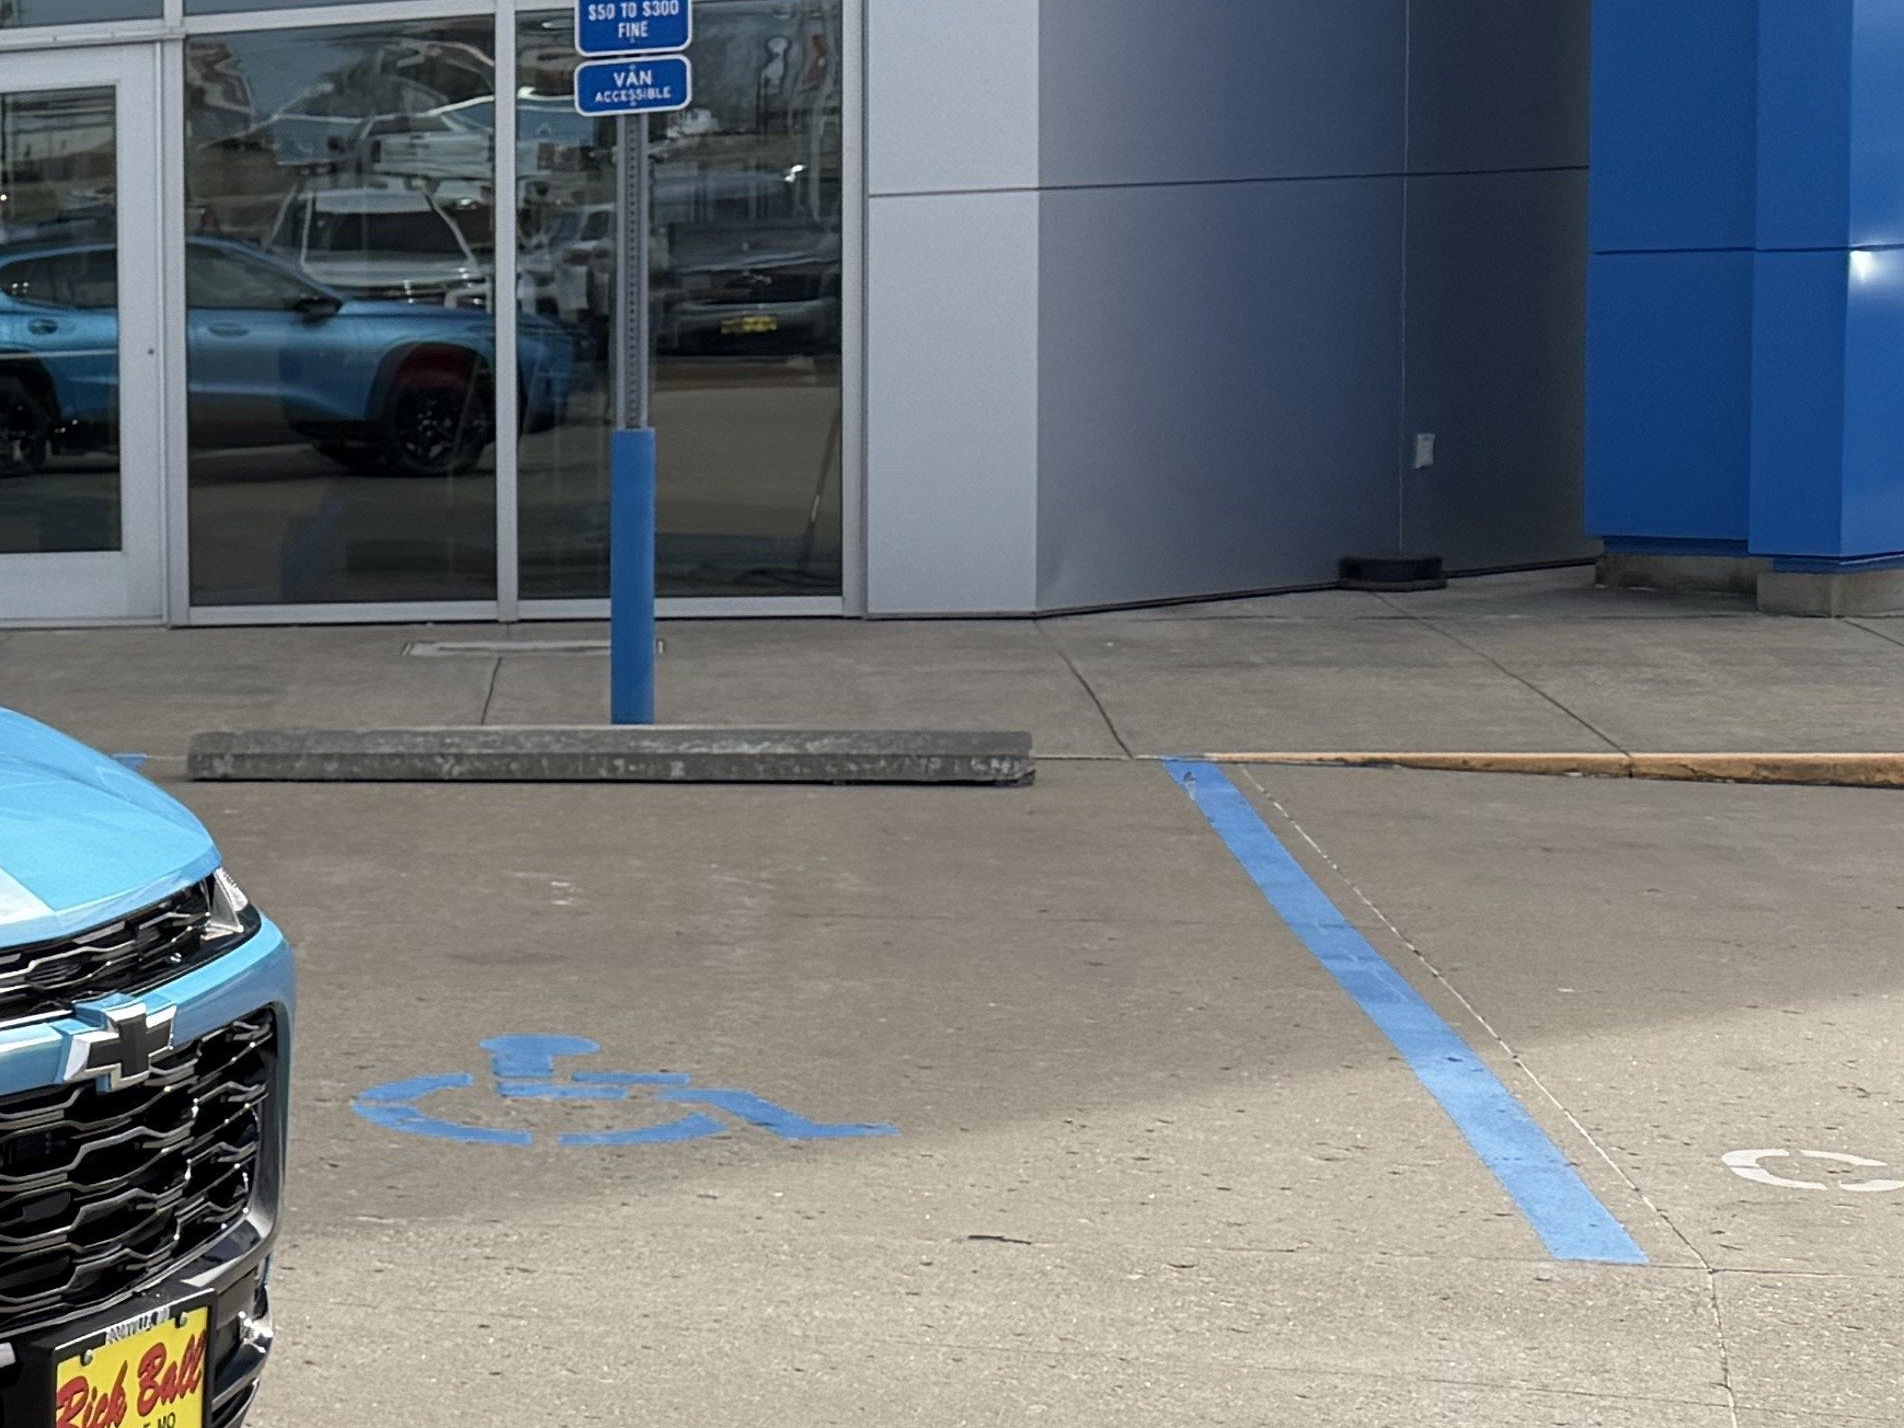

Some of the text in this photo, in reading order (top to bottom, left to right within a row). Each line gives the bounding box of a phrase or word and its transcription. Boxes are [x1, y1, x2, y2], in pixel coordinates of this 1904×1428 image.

[588, 3, 615, 21] $50
[620, 1, 637, 19] TO
[618, 21, 649, 38] FINE
[613, 71, 652, 87] VAN
[595, 86, 670, 103] ACCESSIBLE
[137, 1329, 206, 1416] Ball
